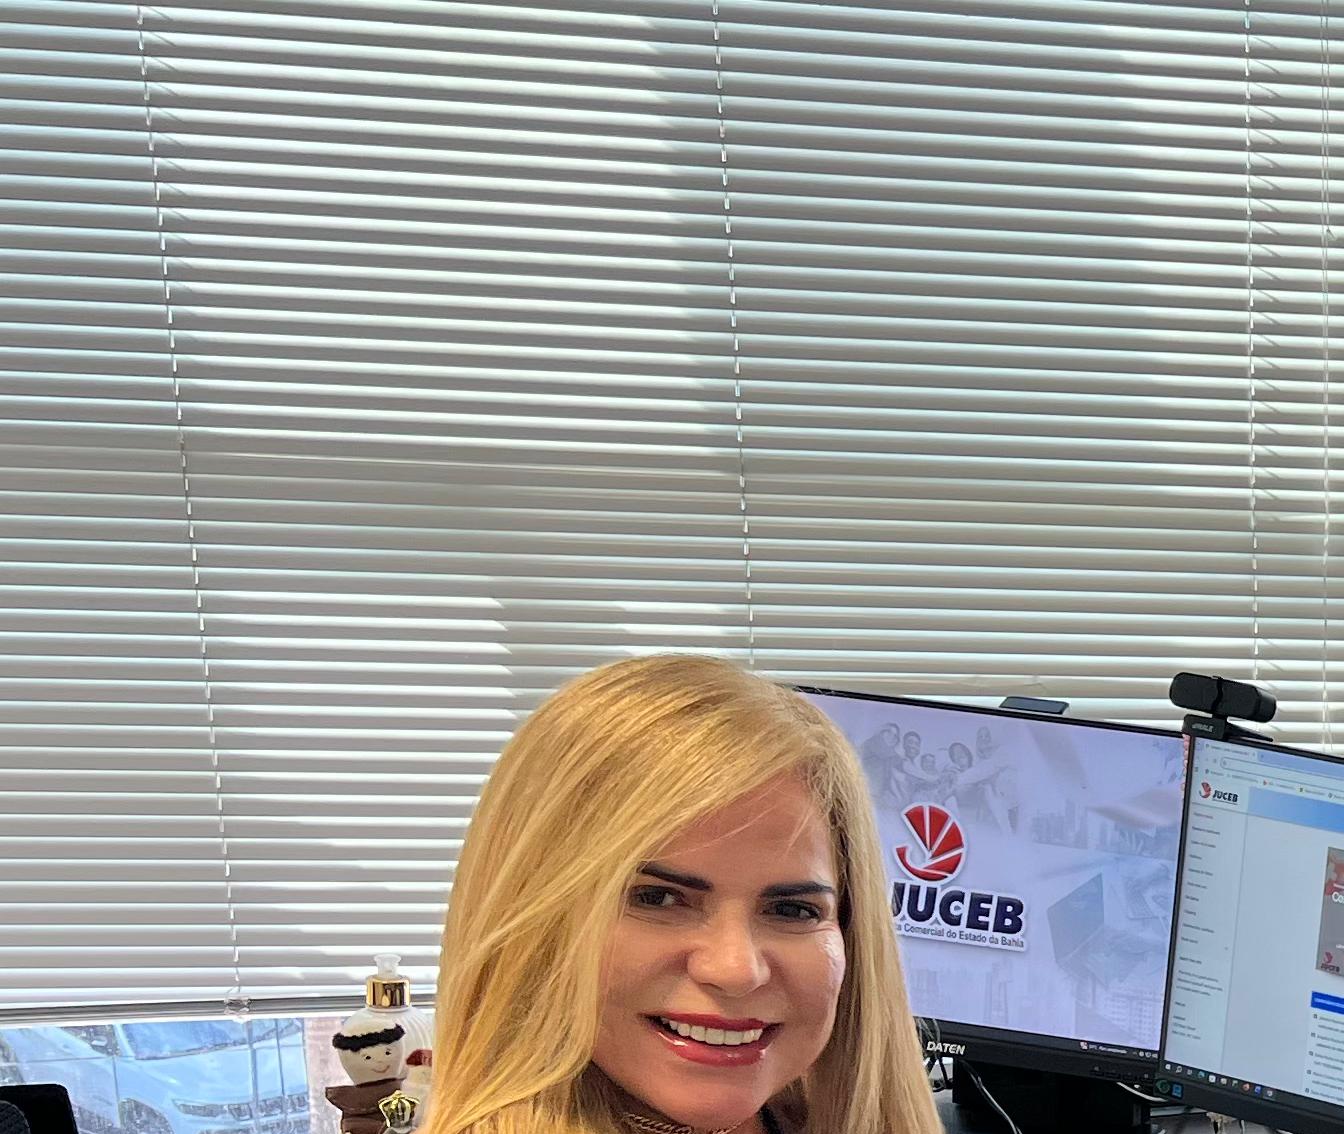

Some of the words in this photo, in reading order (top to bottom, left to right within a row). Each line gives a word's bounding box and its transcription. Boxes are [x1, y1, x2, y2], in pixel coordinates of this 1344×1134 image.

[904, 922, 945, 938] Comercial
[946, 930, 957, 939] do
[959, 931, 987, 944] Estado
[989, 934, 999, 945] da
[1001, 936, 1024, 949] Bahia
[926, 1041, 966, 1056] DATEN
